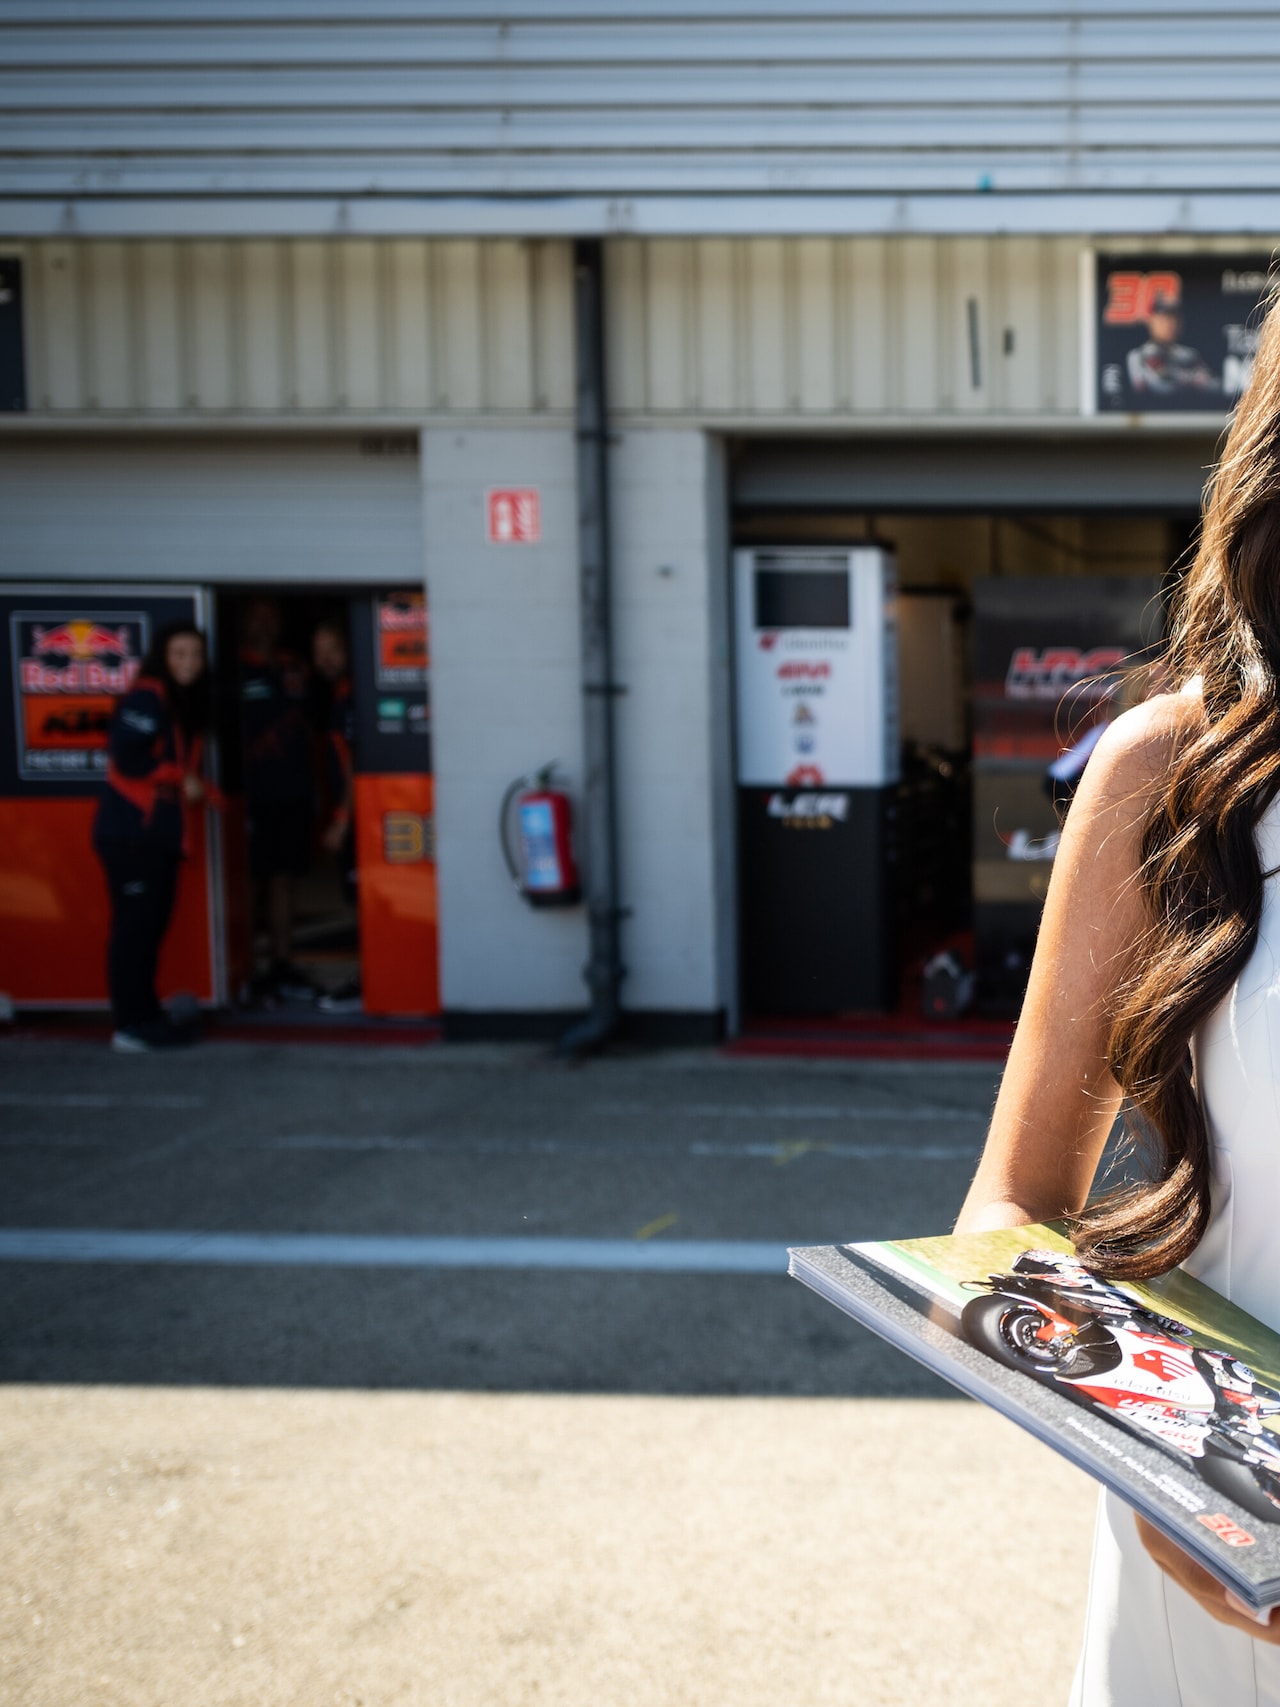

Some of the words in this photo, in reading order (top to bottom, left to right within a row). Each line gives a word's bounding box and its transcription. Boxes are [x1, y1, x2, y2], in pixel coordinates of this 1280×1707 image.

[1104, 271, 1181, 325] 30
[1223, 324, 1264, 353] Ta
[21, 658, 79, 692] Red
[1196, 1512, 1257, 1547] 30
